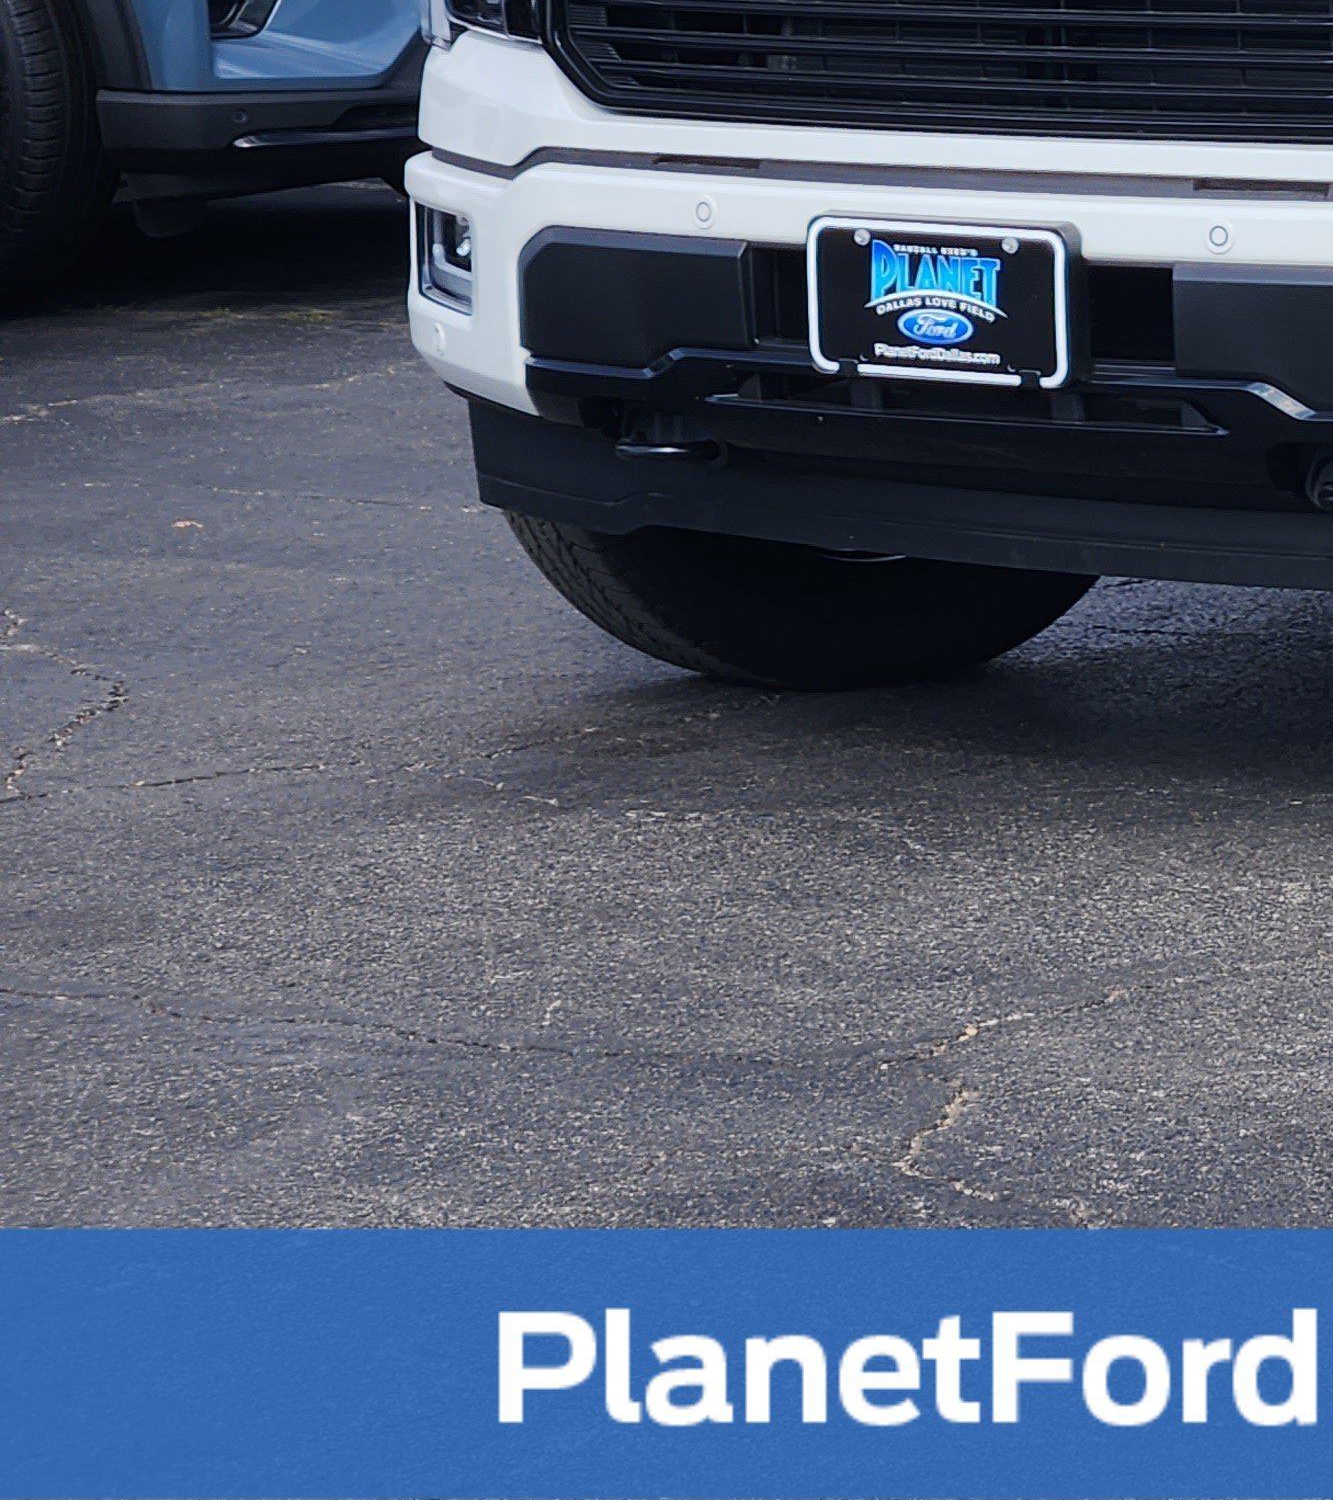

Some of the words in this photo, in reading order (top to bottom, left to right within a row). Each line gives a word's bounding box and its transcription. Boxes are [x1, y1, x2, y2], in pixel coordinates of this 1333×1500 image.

[871, 239, 1001, 308] PLANET
[875, 297, 922, 315] DALLAS
[925, 297, 956, 308] LOVE
[960, 302, 995, 322] FIELD
[914, 313, 959, 338] Ford
